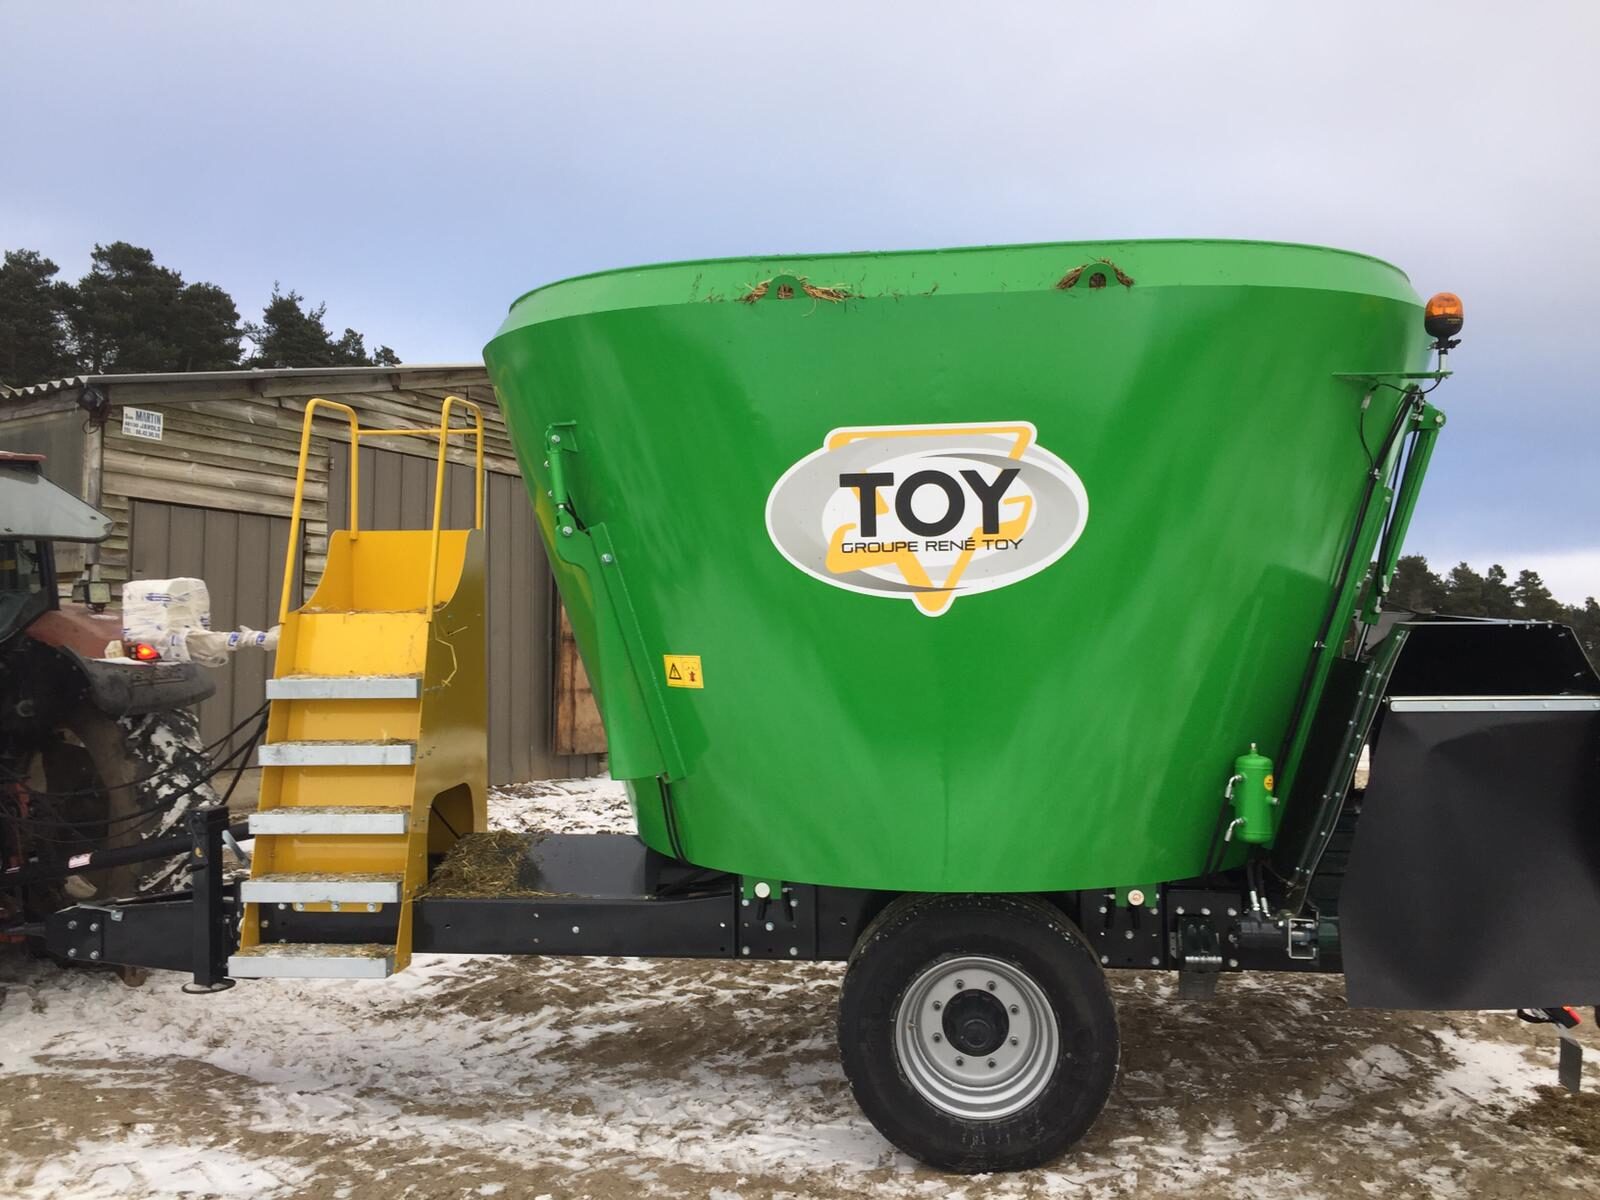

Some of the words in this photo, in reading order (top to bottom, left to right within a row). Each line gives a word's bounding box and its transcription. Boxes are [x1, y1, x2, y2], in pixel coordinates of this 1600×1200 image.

[135, 410, 161, 425] MARTIN
[839, 468, 1021, 538] TOY
[841, 540, 919, 554] GROUPE
[925, 536, 976, 552] RENÉ
[982, 538, 1024, 551] TOY
